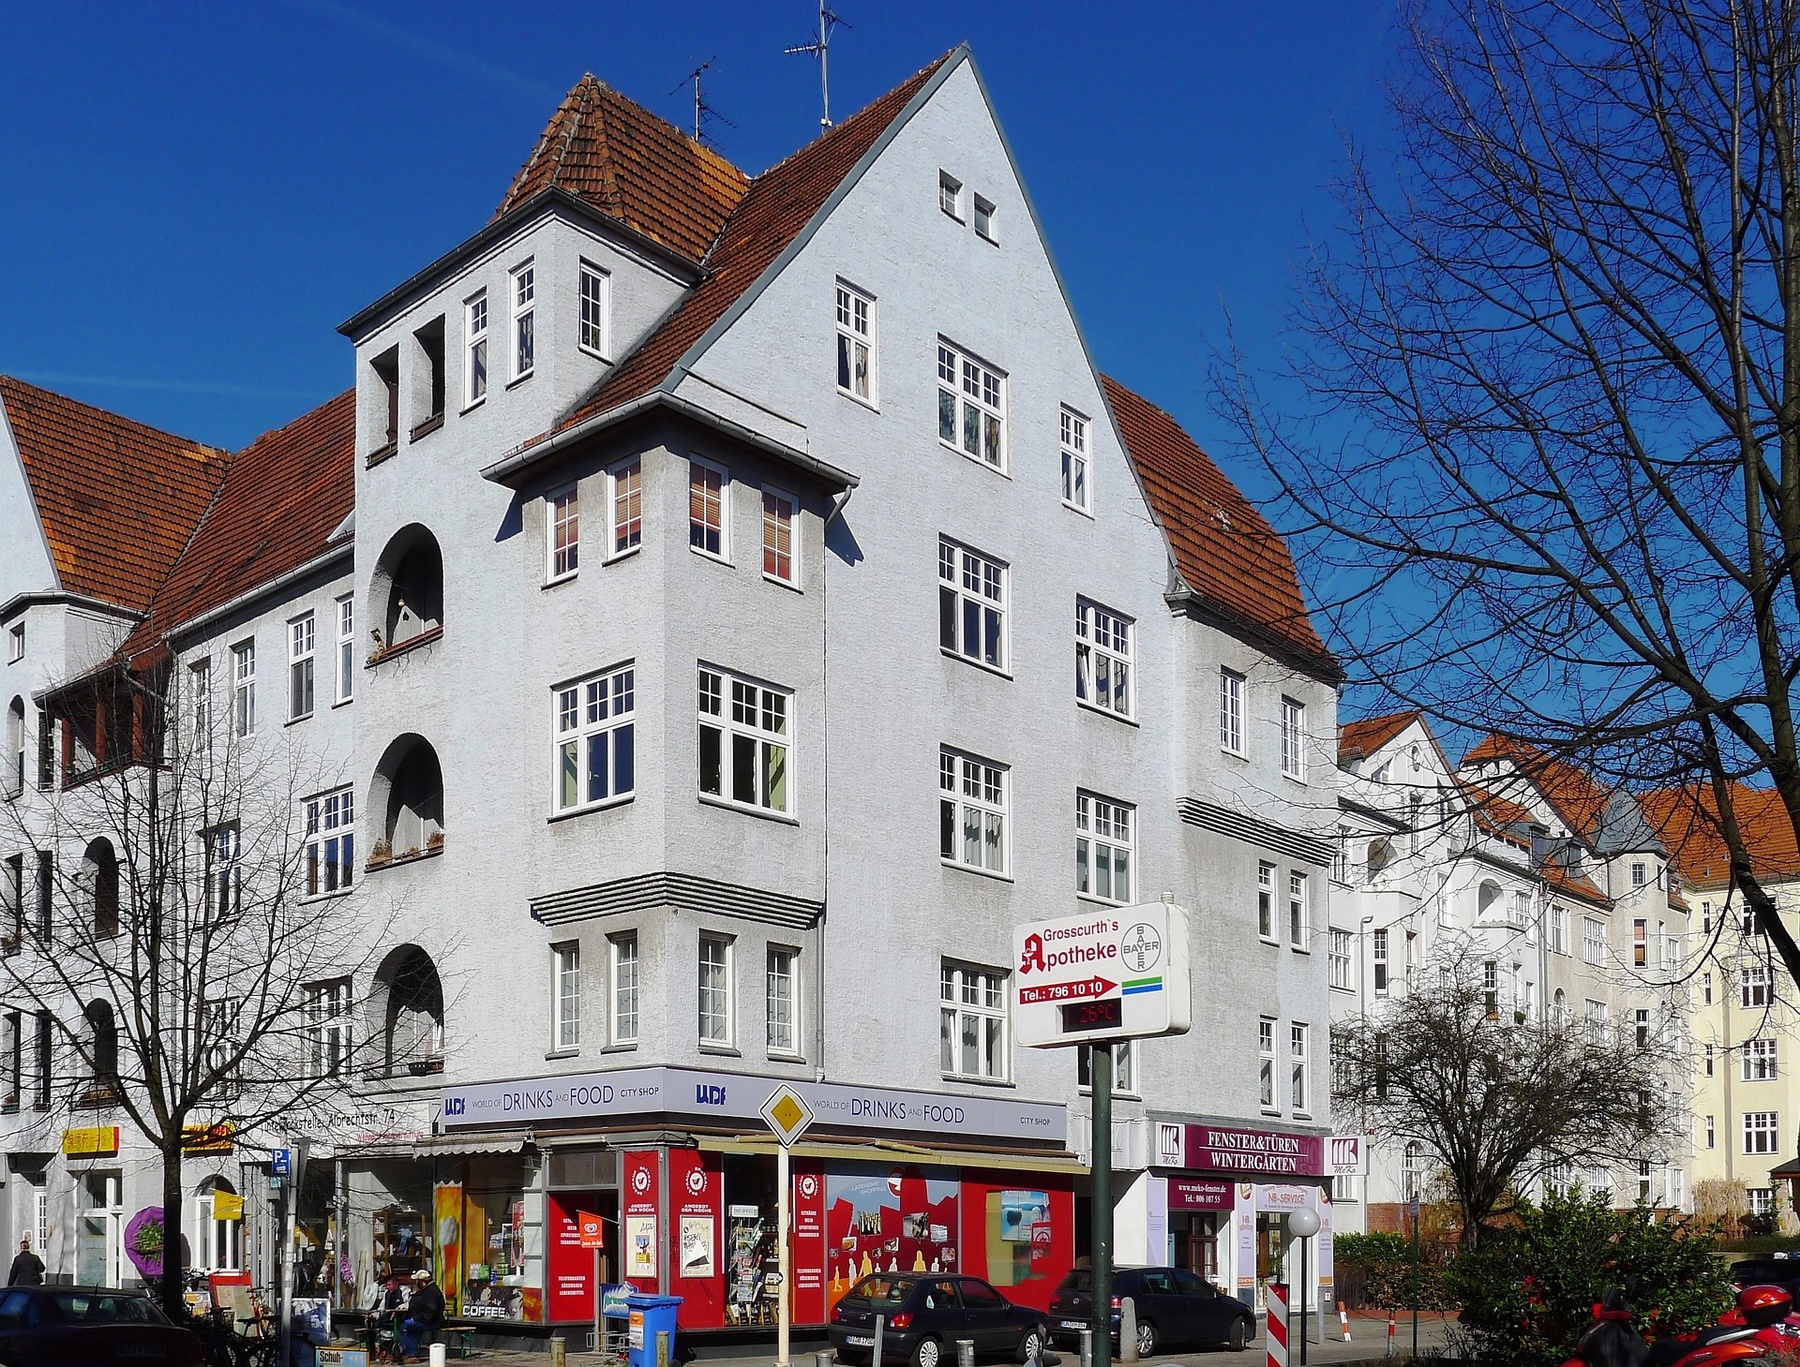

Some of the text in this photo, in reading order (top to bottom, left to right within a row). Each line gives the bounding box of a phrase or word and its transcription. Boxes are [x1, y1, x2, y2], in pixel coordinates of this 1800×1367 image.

[1019, 932, 1118, 975] Apotheke
[1122, 941, 1160, 954] BAYER
[1136, 926, 1145, 970] BAYER
[1022, 981, 1103, 1002] Tel.: 796 10 10
[471, 1085, 615, 1111] WORLD OF DRINKS AND FOOD
[620, 1086, 660, 1098] CITY SHOP
[384, 1108, 395, 1124] 74
[813, 1098, 965, 1124] WORLD OF DRINKS AND FOOD
[1020, 1116, 1051, 1126] CITY SHOP
[1208, 1131, 1299, 1152] FENSTER&TÜREN
[274, 1150, 283, 1163] P
[1210, 1152, 1297, 1172] WINTERGÄRTEN
[1214, 1195, 1221, 1204] 55
[462, 1304, 506, 1318] COFFEE
[319, 1351, 343, 1363] Schuh-
